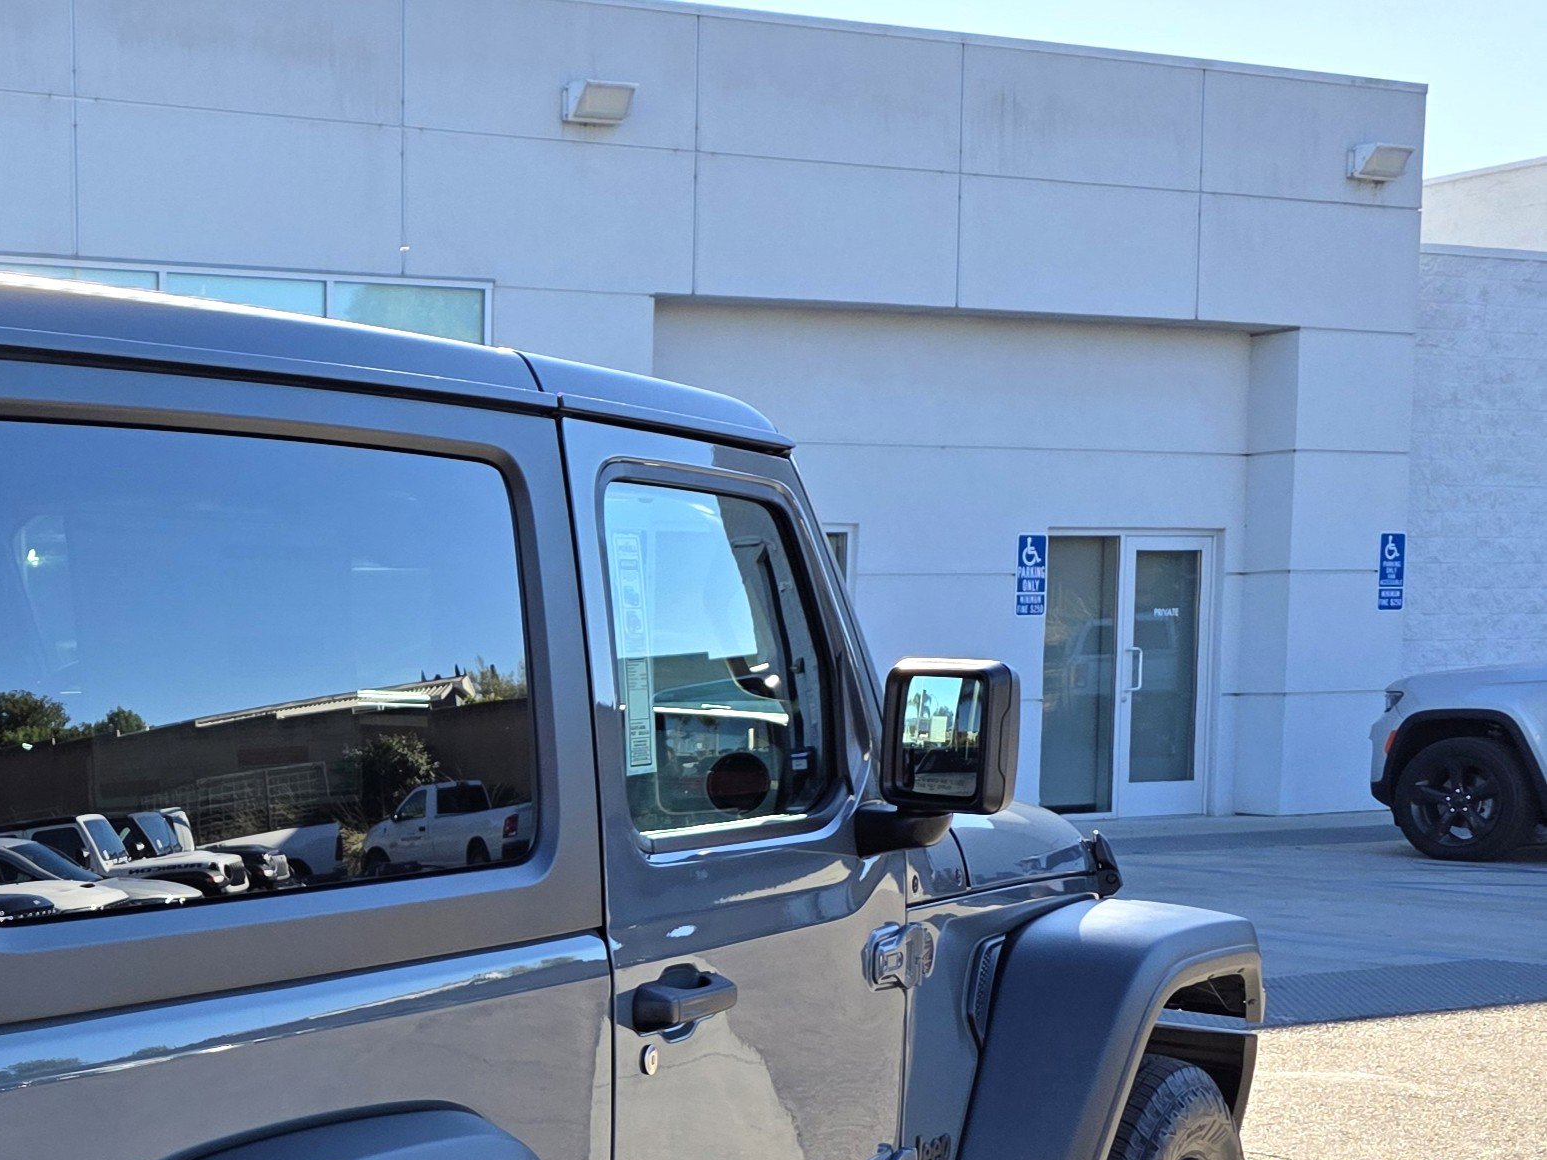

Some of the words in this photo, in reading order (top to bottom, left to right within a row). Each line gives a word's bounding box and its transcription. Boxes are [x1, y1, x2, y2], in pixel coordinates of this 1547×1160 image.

[1017, 566, 1046, 579] PARKING
[1022, 579, 1040, 592] ONLY
[1153, 607, 1179, 617] PRIVATE
